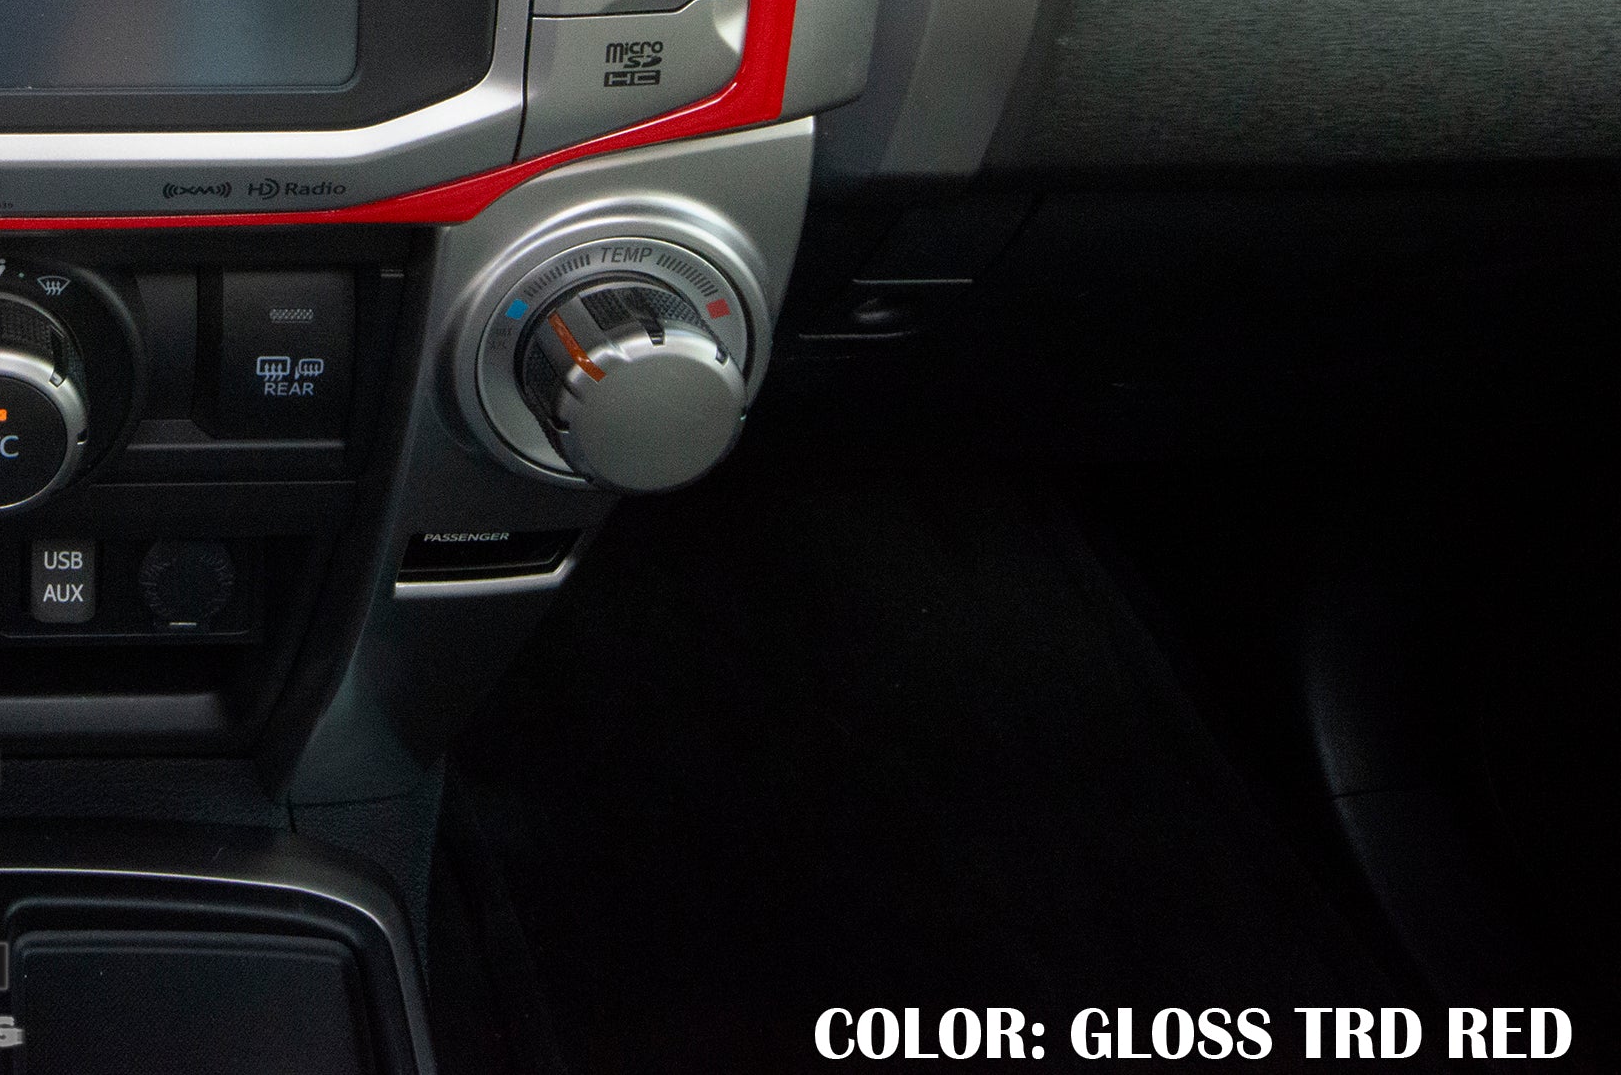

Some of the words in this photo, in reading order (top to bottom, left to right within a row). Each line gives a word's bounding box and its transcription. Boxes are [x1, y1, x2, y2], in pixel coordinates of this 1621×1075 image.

[285, 182, 347, 196] Radio
[599, 247, 653, 264] TEMP
[264, 382, 314, 396] REAR
[423, 532, 510, 543] PASSENGER
[44, 551, 83, 569] USB
[43, 584, 83, 602] AUX
